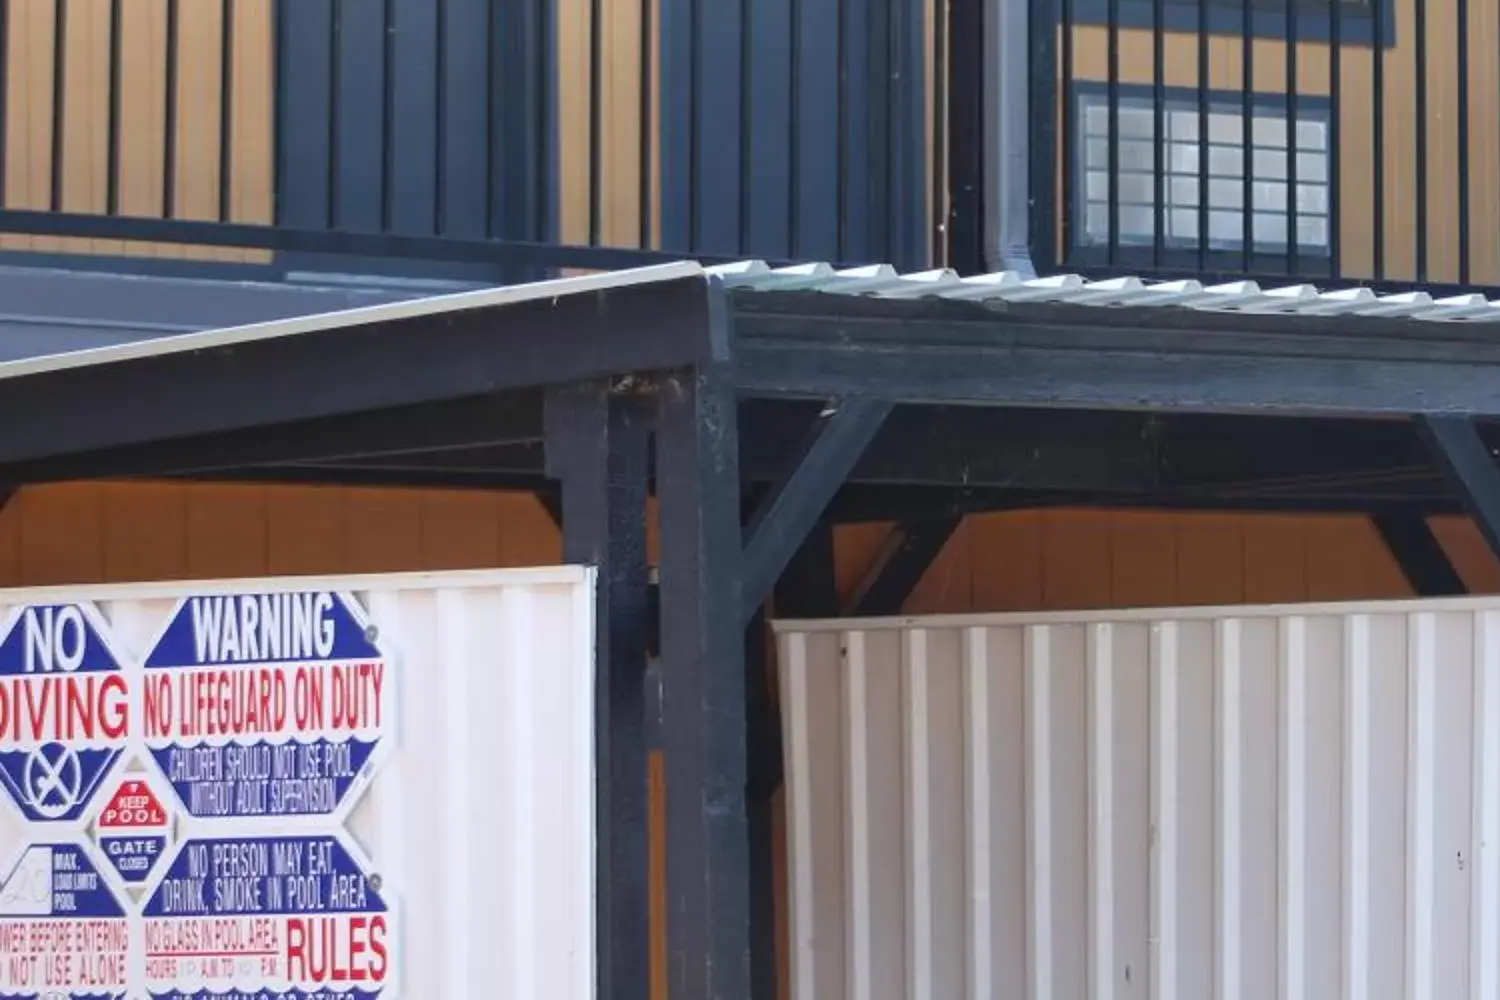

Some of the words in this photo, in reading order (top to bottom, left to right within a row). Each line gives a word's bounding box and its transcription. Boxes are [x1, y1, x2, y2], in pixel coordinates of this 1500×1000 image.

[25, 605, 86, 672] NO
[192, 592, 335, 662] WARNING
[144, 673, 173, 737] NO
[180, 668, 287, 737] LIFEGUARD
[295, 665, 325, 731] ON
[332, 664, 384, 729] DUTY
[169, 747, 223, 781] CHILDREN
[226, 746, 271, 780] SHOULD
[274, 745, 297, 779] NOT
[299, 744, 321, 779] USE
[325, 743, 354, 777] POOL
[118, 796, 149, 809] KEEP
[237, 780, 269, 814] ADULT
[106, 809, 162, 823] POOL
[109, 840, 157, 855] GATE
[188, 844, 209, 878] NO
[213, 843, 268, 877] PERSON
[273, 842, 302, 875] MAY
[215, 877, 263, 911] SMOKE
[266, 876, 283, 910] IN
[287, 876, 325, 909] POOL
[329, 874, 368, 908] AREA
[31, 921, 71, 953] BEFORE
[76, 919, 128, 952] ENTERING
[145, 920, 161, 951] NO
[163, 919, 199, 950] GLASS
[216, 919, 245, 950] POOL
[248, 918, 279, 949] AREA
[287, 915, 387, 982] RULES
[10, 955, 37, 986] NOT
[45, 954, 71, 985] USE
[80, 954, 126, 985] ALONE
